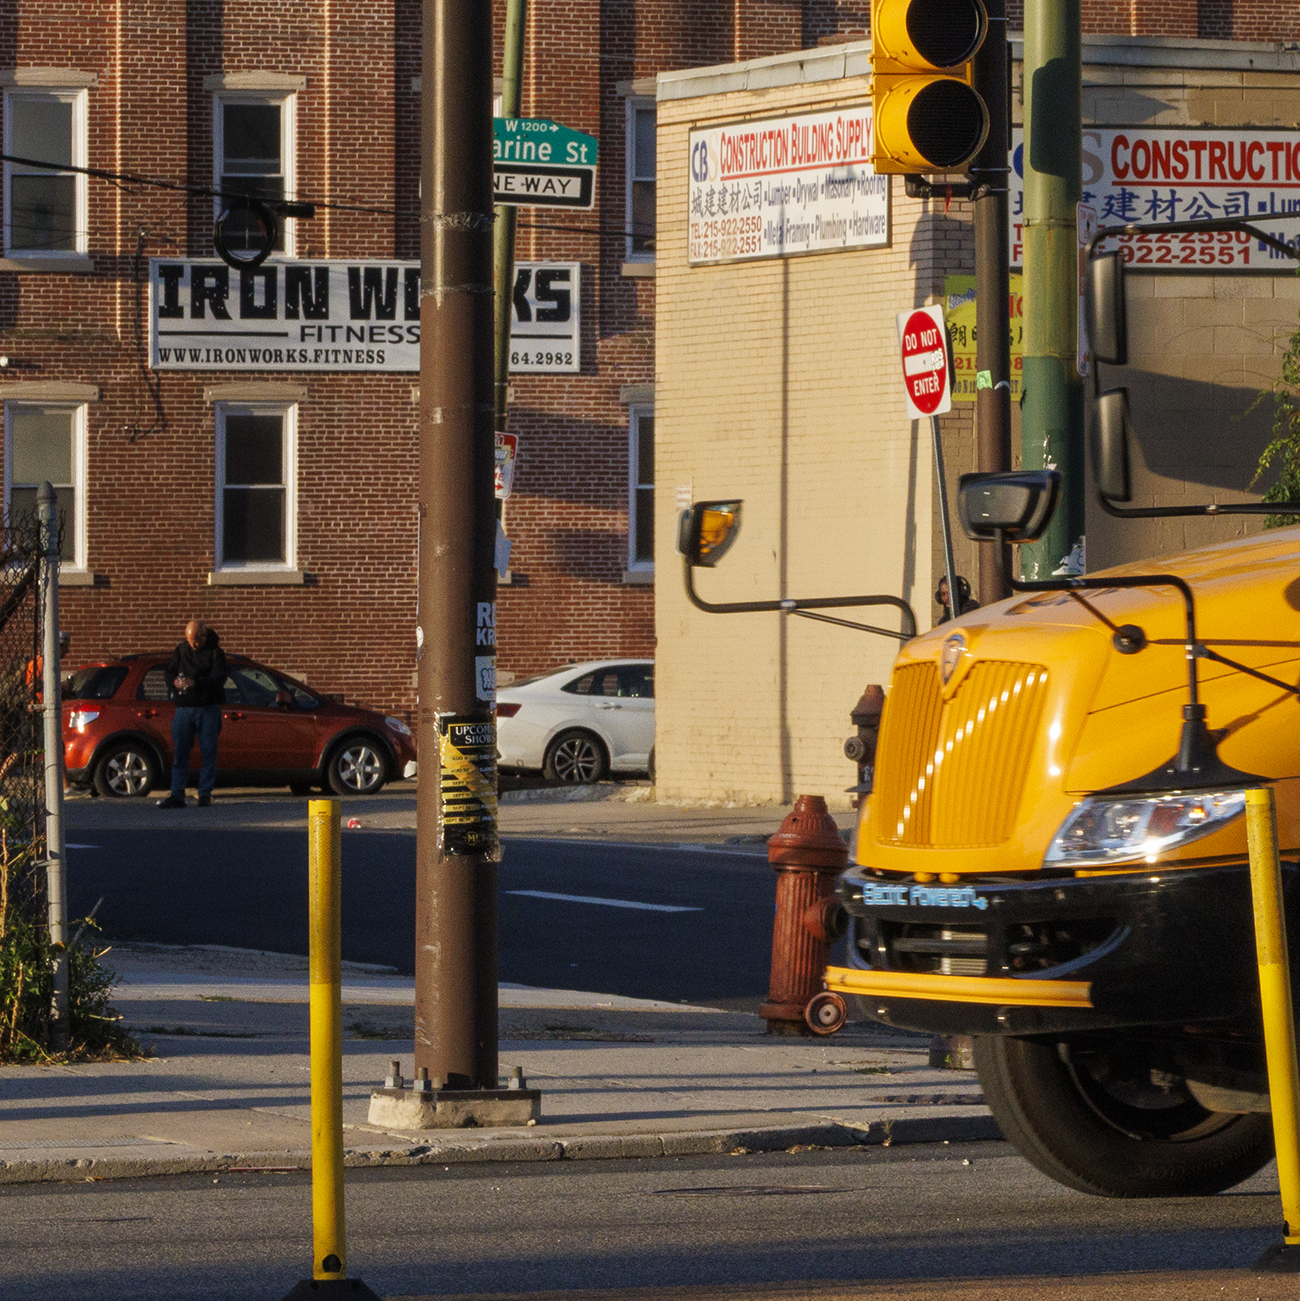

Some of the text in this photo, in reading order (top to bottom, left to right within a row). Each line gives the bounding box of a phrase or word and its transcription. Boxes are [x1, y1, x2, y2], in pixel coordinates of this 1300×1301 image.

[505, 120, 547, 132] W 1200
[493, 135, 588, 164] arine St
[691, 115, 872, 183] CBS CONSTRUCTION BUILDING SUPPLY
[525, 177, 571, 195] WAY
[767, 179, 791, 207] Lumber
[1013, 188, 1250, 224] 建材公司
[767, 209, 886, 249] Metal Framing Plumbing Hardware
[158, 264, 329, 321] IRON
[905, 333, 917, 351] DO
[921, 328, 937, 348] NOT
[158, 349, 573, 366] WWW.IRONWORKS.FITNESS 64.2982
[914, 376, 940, 397] ENTER
